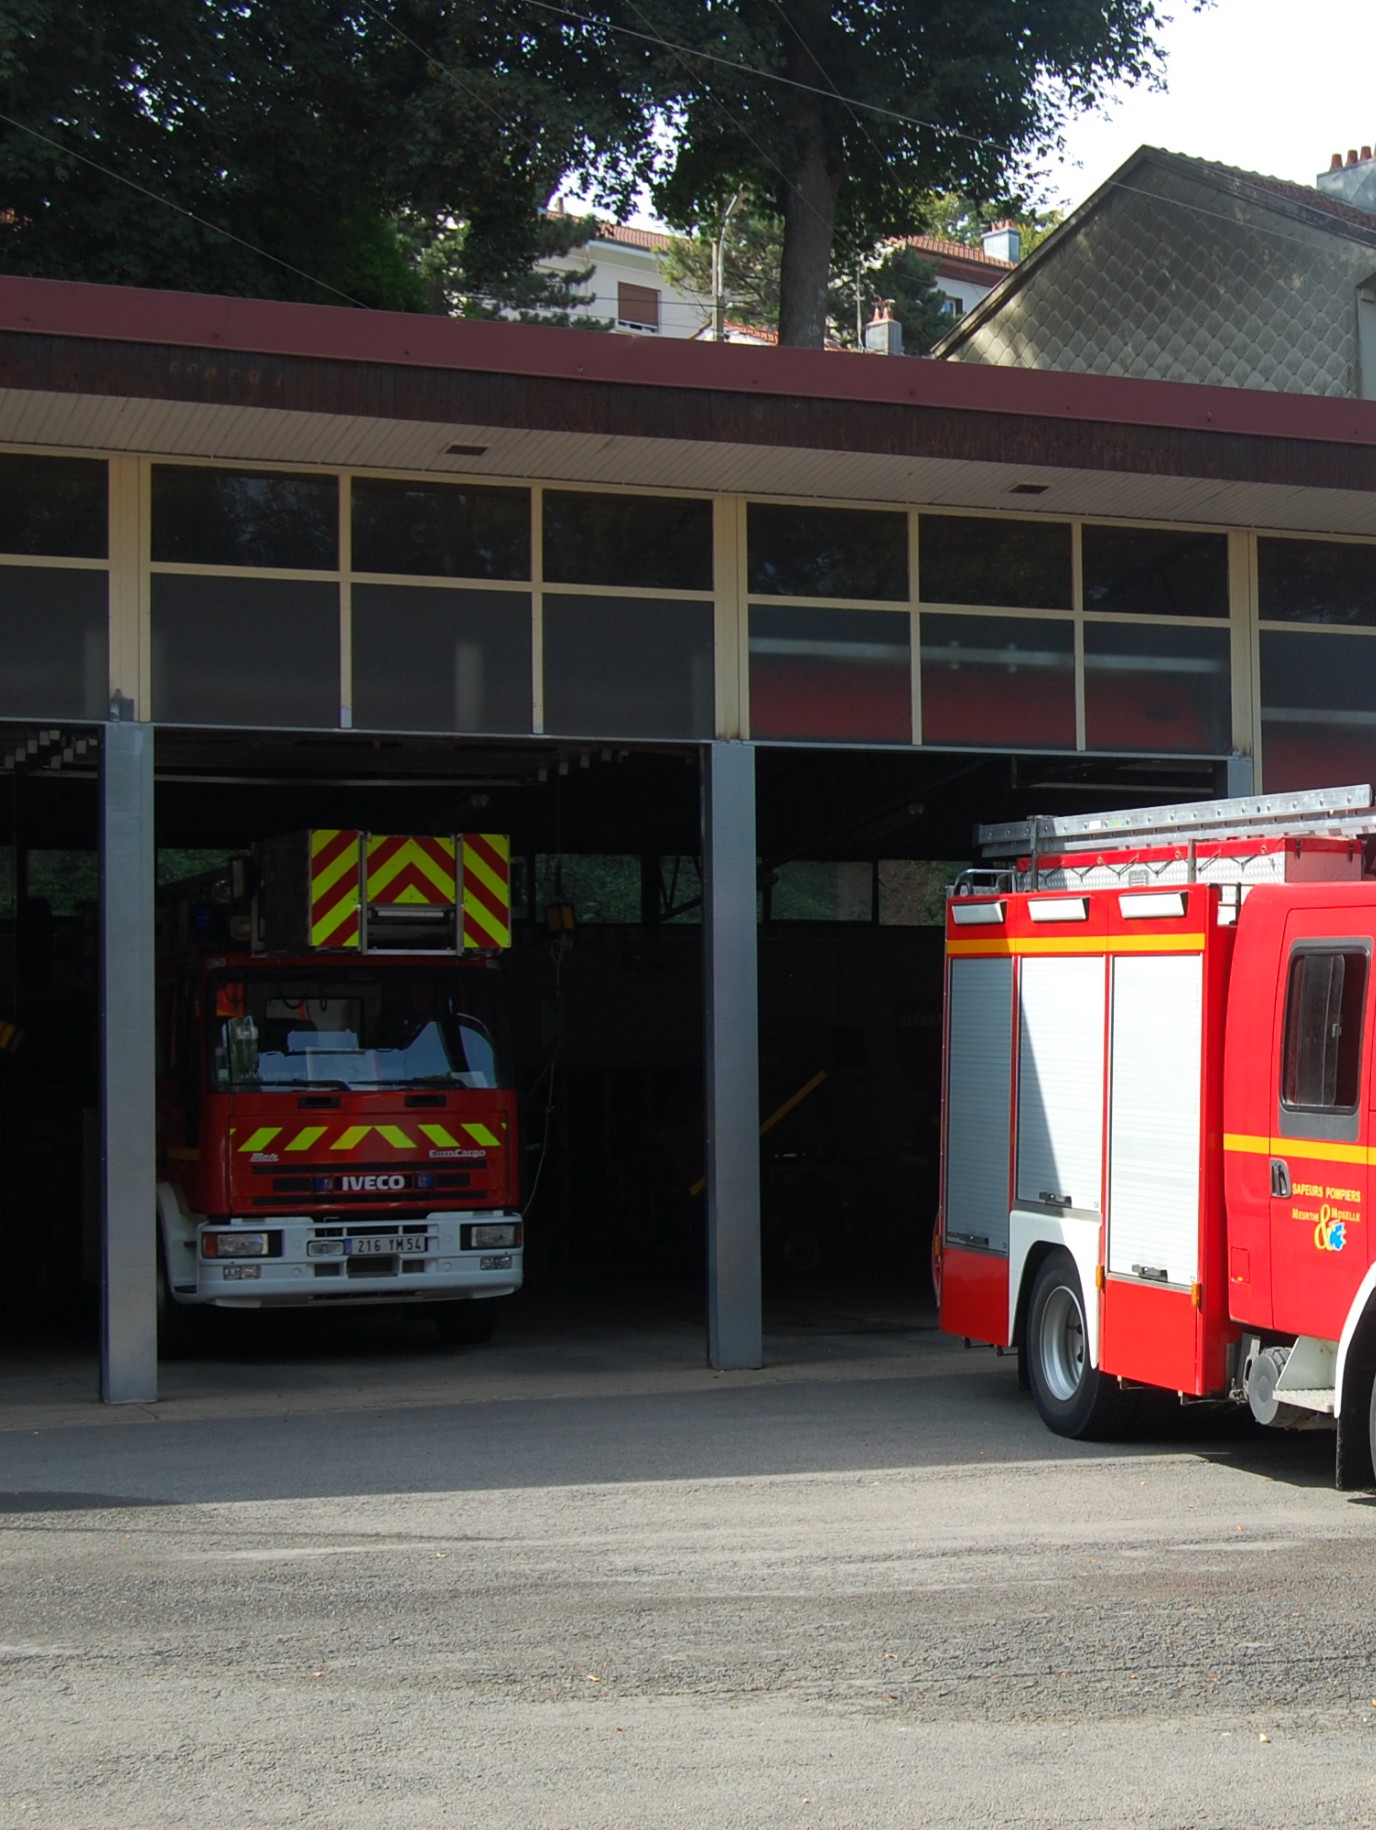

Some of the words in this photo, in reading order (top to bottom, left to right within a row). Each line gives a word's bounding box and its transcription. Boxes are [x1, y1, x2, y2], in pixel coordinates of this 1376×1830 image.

[342, 1175, 405, 1191] IVECO
[1292, 1183, 1323, 1198] SAPEURS
[1326, 1186, 1361, 1203] POMPIERS
[1292, 1208, 1319, 1222] MEURTHE
[1331, 1208, 1361, 1222] MOSELLE
[358, 1239, 381, 1253] 216
